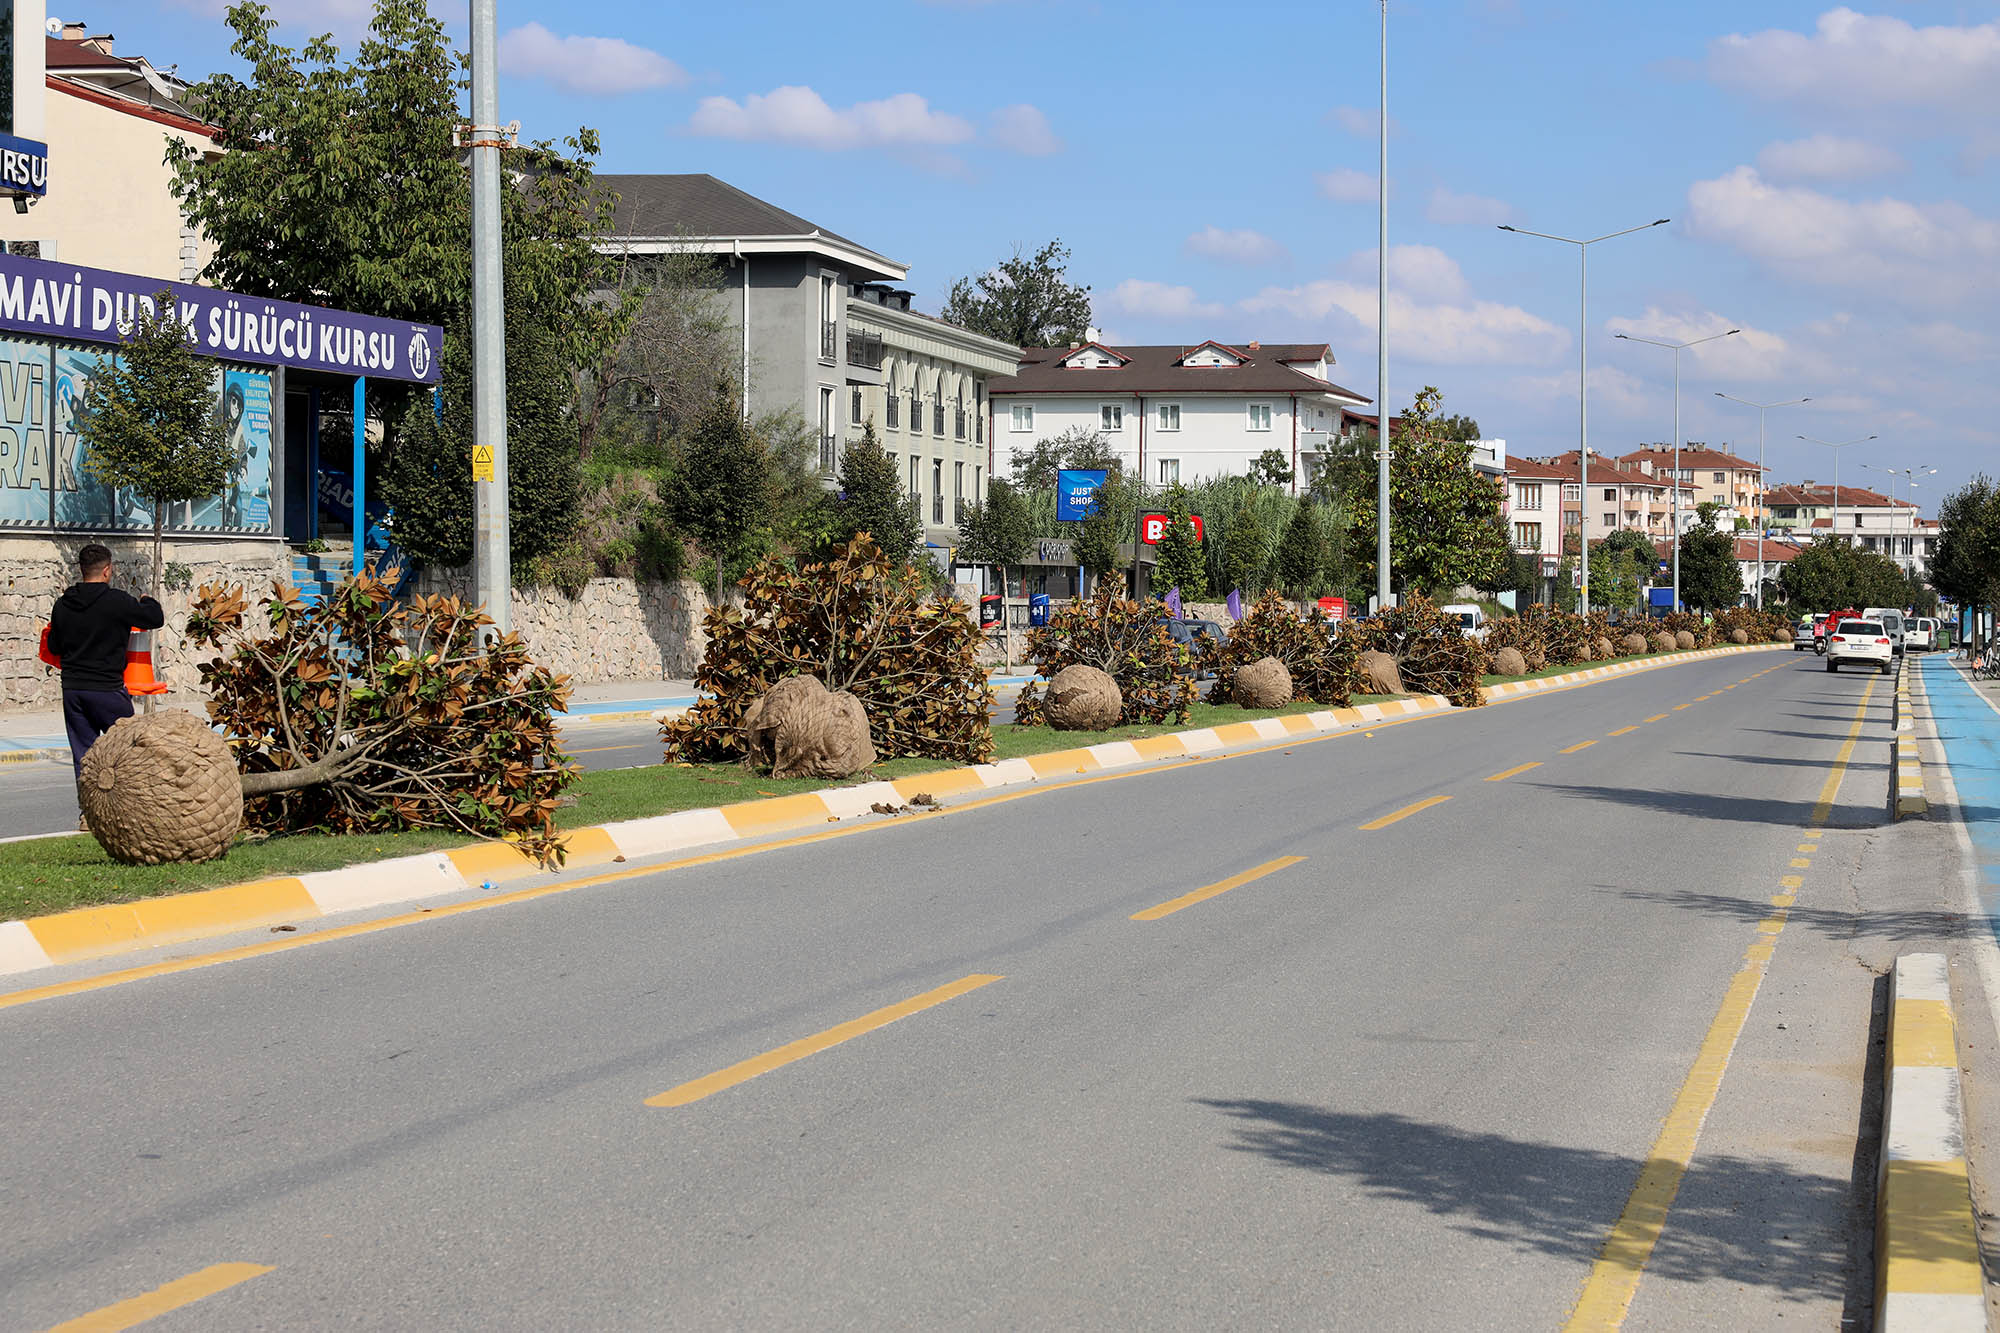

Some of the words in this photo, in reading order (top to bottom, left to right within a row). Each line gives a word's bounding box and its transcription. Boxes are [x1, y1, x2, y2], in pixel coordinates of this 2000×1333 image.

[0, 148, 45, 187] RSU
[207, 299, 313, 360] SÜRÜCÜ
[319, 323, 396, 371] KURSU
[1070, 496, 1093, 505] SHOP
[1071, 487, 1093, 495] JUST
